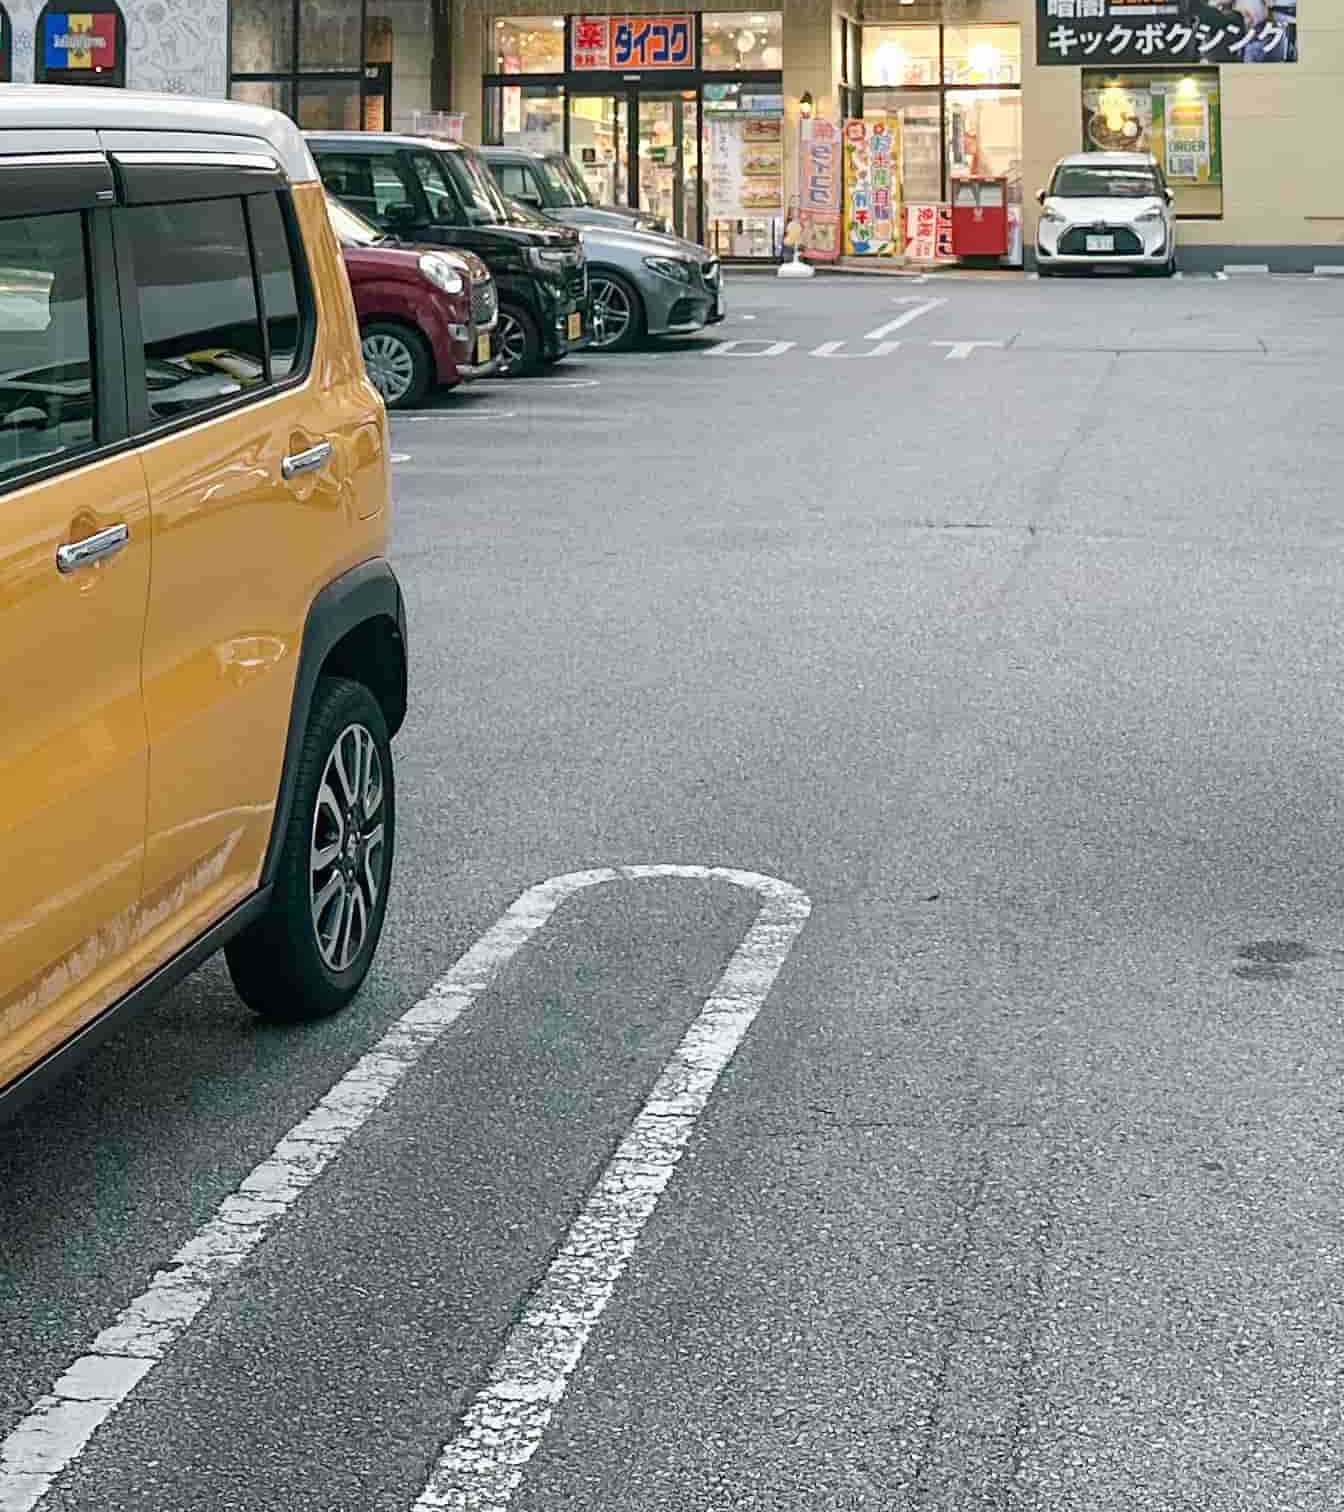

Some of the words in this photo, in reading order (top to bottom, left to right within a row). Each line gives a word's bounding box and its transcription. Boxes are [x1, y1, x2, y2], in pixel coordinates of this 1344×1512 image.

[615, 22, 689, 64] ダイコク
[1047, 21, 1290, 56] キックボクシング
[703, 339, 1008, 361] OUT
